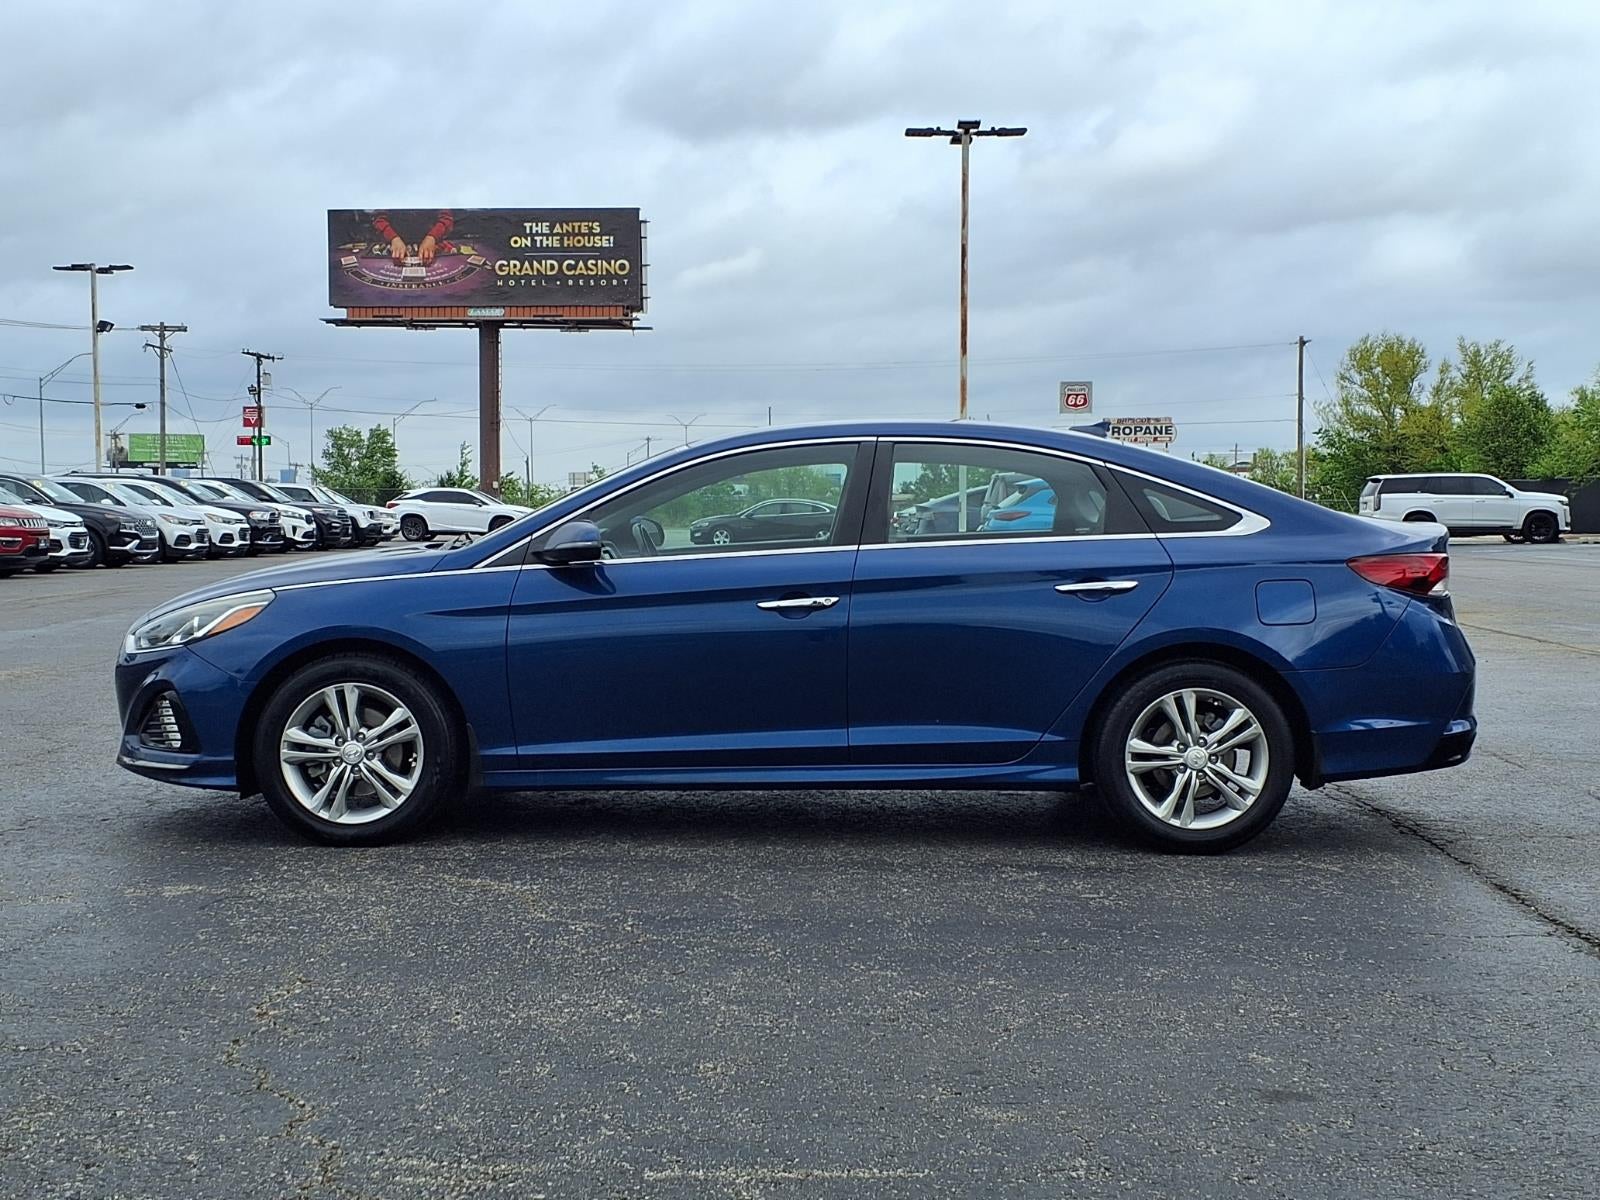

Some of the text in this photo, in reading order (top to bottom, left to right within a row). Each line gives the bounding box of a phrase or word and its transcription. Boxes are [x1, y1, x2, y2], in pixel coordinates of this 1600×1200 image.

[524, 222, 601, 233] THE ANTE'S
[510, 236, 614, 248] ON THE HOUSE!
[495, 259, 630, 275] GRAND CASINO
[497, 279, 547, 287] HOTEL
[1067, 394, 1085, 405] 66
[1110, 425, 1174, 436] ROPANE
